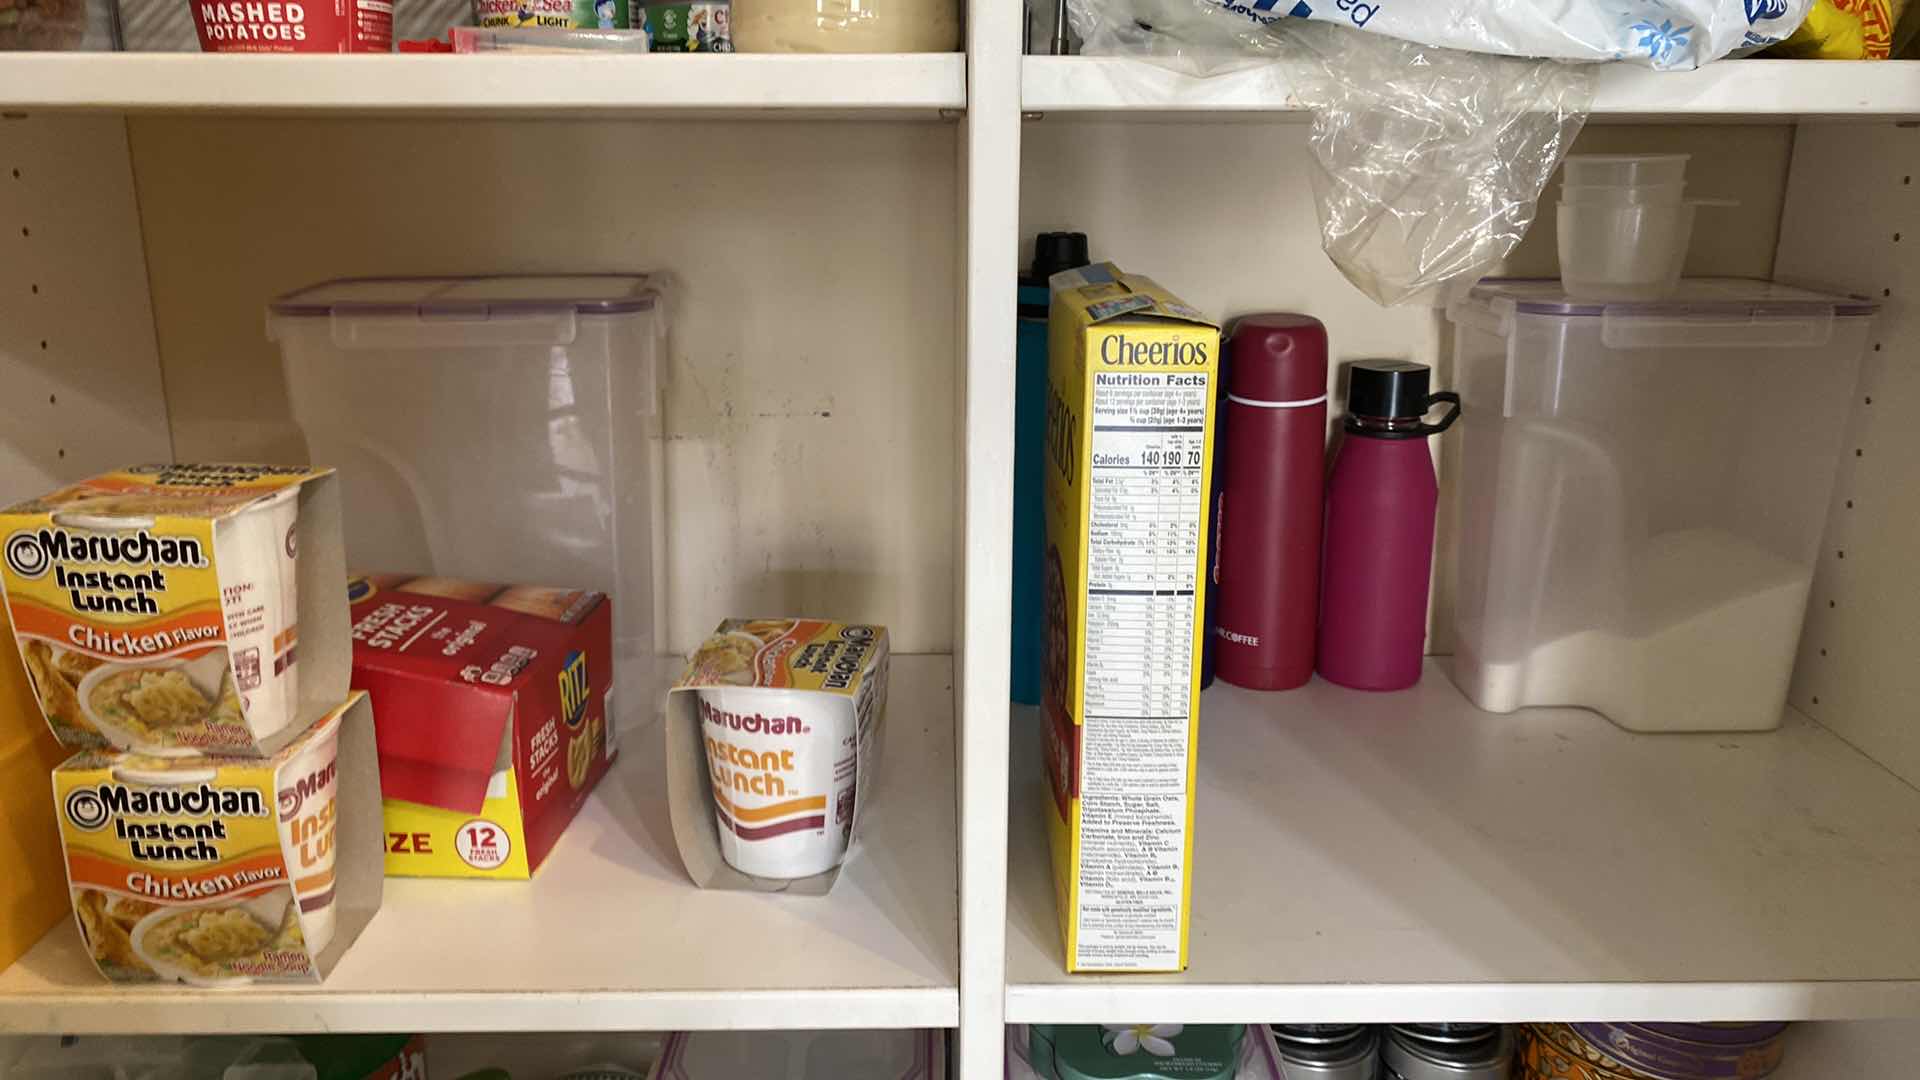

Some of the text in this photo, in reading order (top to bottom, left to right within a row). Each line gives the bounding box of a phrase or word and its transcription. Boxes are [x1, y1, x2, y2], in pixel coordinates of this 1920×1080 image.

[201, 3, 304, 23] MASHED
[537, 15, 569, 28] LIGHT
[206, 24, 305, 40] POTATOES
[1101, 334, 1208, 366] Cheerios
[1096, 374, 1206, 386] Nutrition Facts
[1093, 451, 1200, 465] Calories 140 190 70
[38, 529, 202, 565] Maruchan
[55, 565, 166, 592] Instant
[71, 589, 159, 614] Lunch
[352, 603, 405, 640] FRESH
[368, 605, 434, 648] STACKS
[68, 623, 220, 656] Chicken Flavor
[558, 651, 590, 724] RITZ
[530, 729, 559, 771] STACKS
[531, 716, 556, 753] FRESH
[705, 736, 795, 772] nstant
[99, 784, 261, 816] Maruchan
[116, 817, 226, 842] Instant
[466, 827, 497, 849] 12
[131, 840, 219, 862] Lunch
[127, 866, 281, 899] Chicken Flavor
